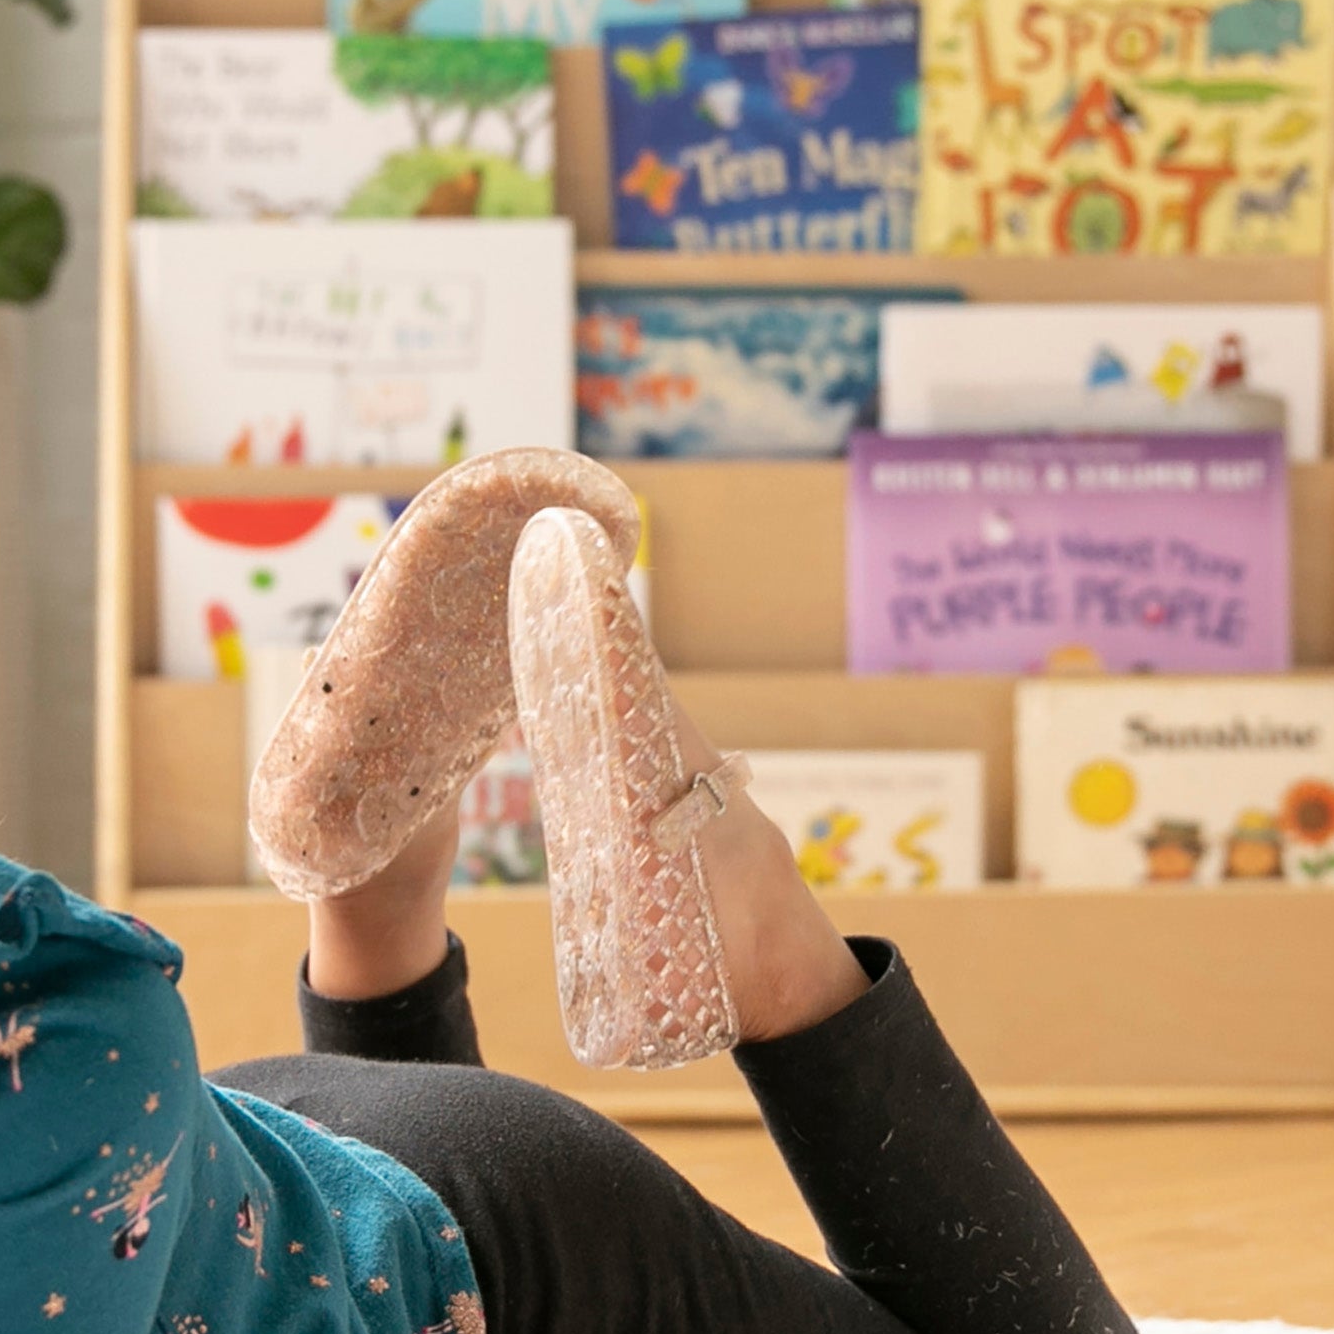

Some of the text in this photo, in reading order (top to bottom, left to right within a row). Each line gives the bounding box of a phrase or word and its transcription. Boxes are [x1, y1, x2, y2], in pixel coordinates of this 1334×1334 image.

[1019, 2, 1210, 73] SPOT
[1047, 78, 1135, 173] A
[680, 139, 786, 205] Ten
[889, 576, 1247, 650] PURPLE PEOPLE
[1124, 714, 1320, 751] Sunshine
